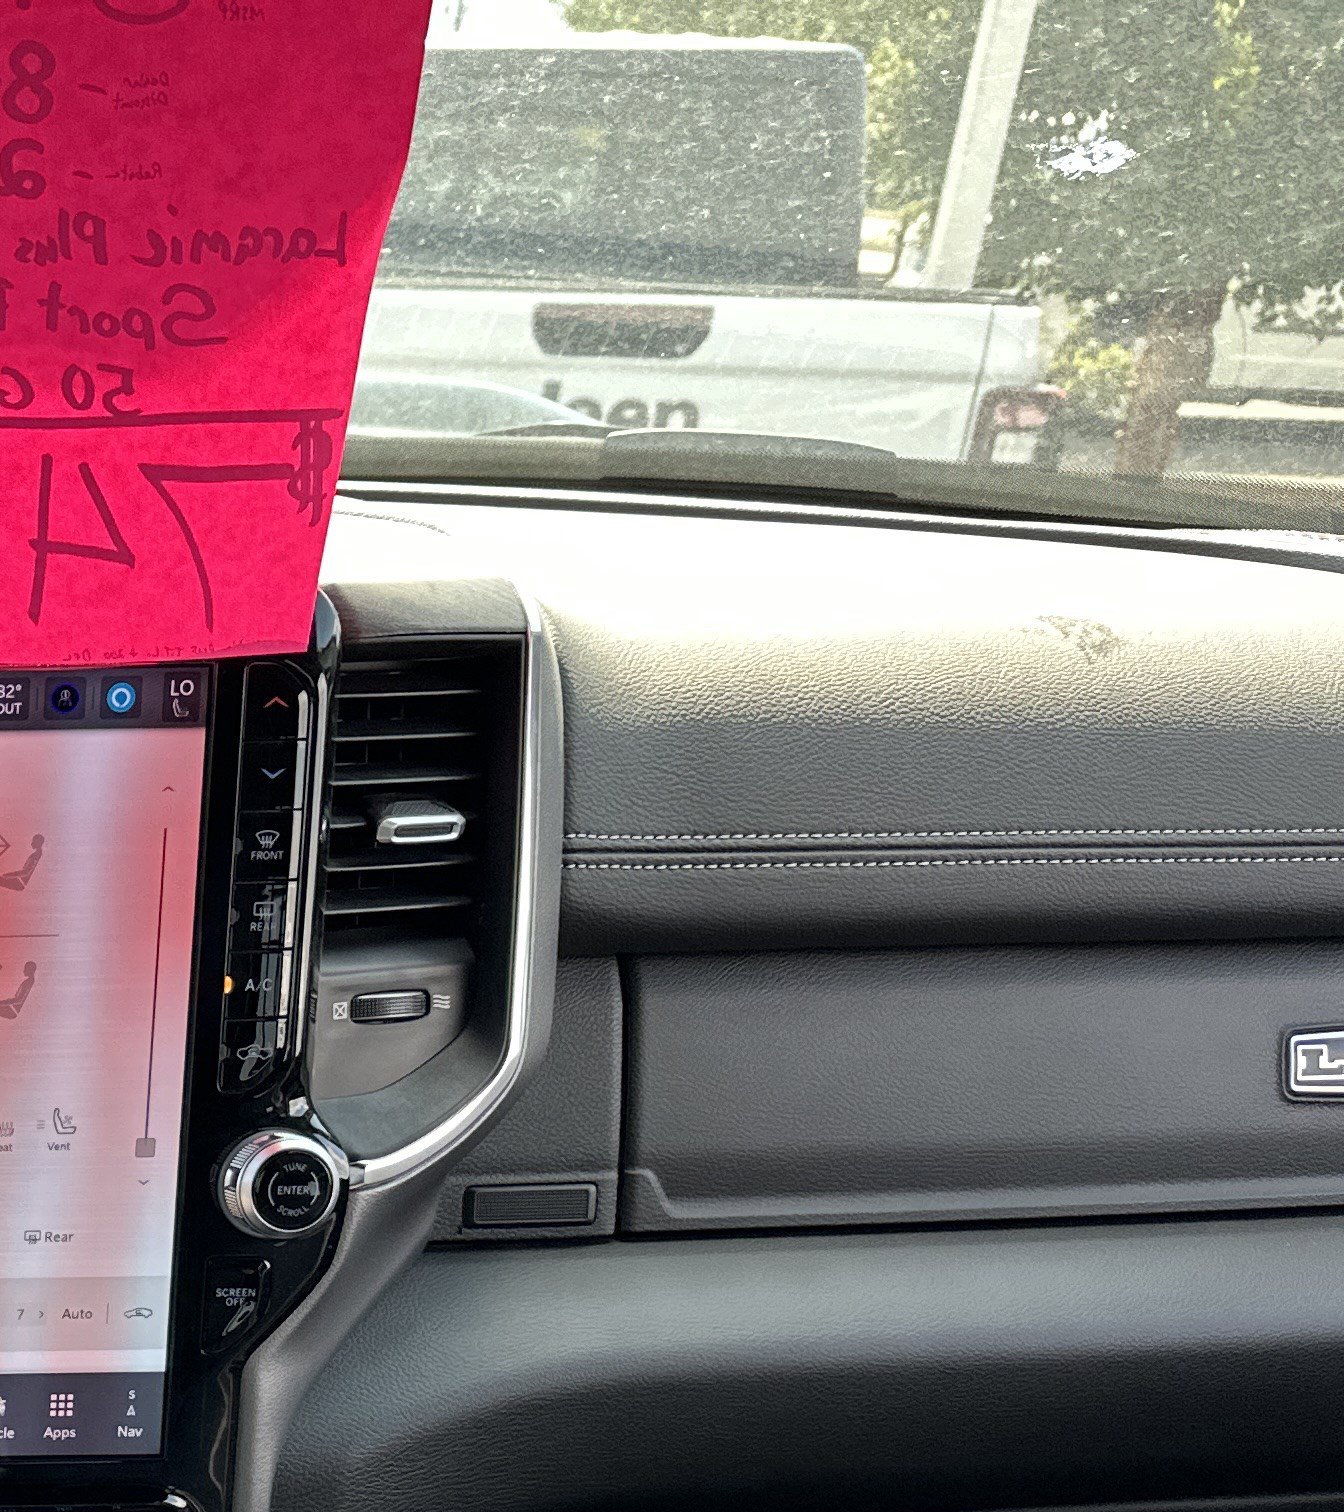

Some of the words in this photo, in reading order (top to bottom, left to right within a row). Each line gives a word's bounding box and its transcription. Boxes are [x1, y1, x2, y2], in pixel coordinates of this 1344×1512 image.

[170, 680, 194, 696] LO
[250, 851, 284, 860] FRONT
[244, 978, 274, 992] A/C
[47, 1141, 71, 1152] Vent
[283, 1162, 308, 1173] TUNE
[277, 1185, 310, 1196] ENTER
[276, 1205, 311, 1218] SCROLL
[44, 1231, 75, 1243] Rear
[215, 1288, 257, 1298] SCREEN
[16, 1308, 25, 1320] 7
[61, 1307, 93, 1320] Auto
[43, 1426, 77, 1441] Apps
[117, 1425, 143, 1438] Nav
